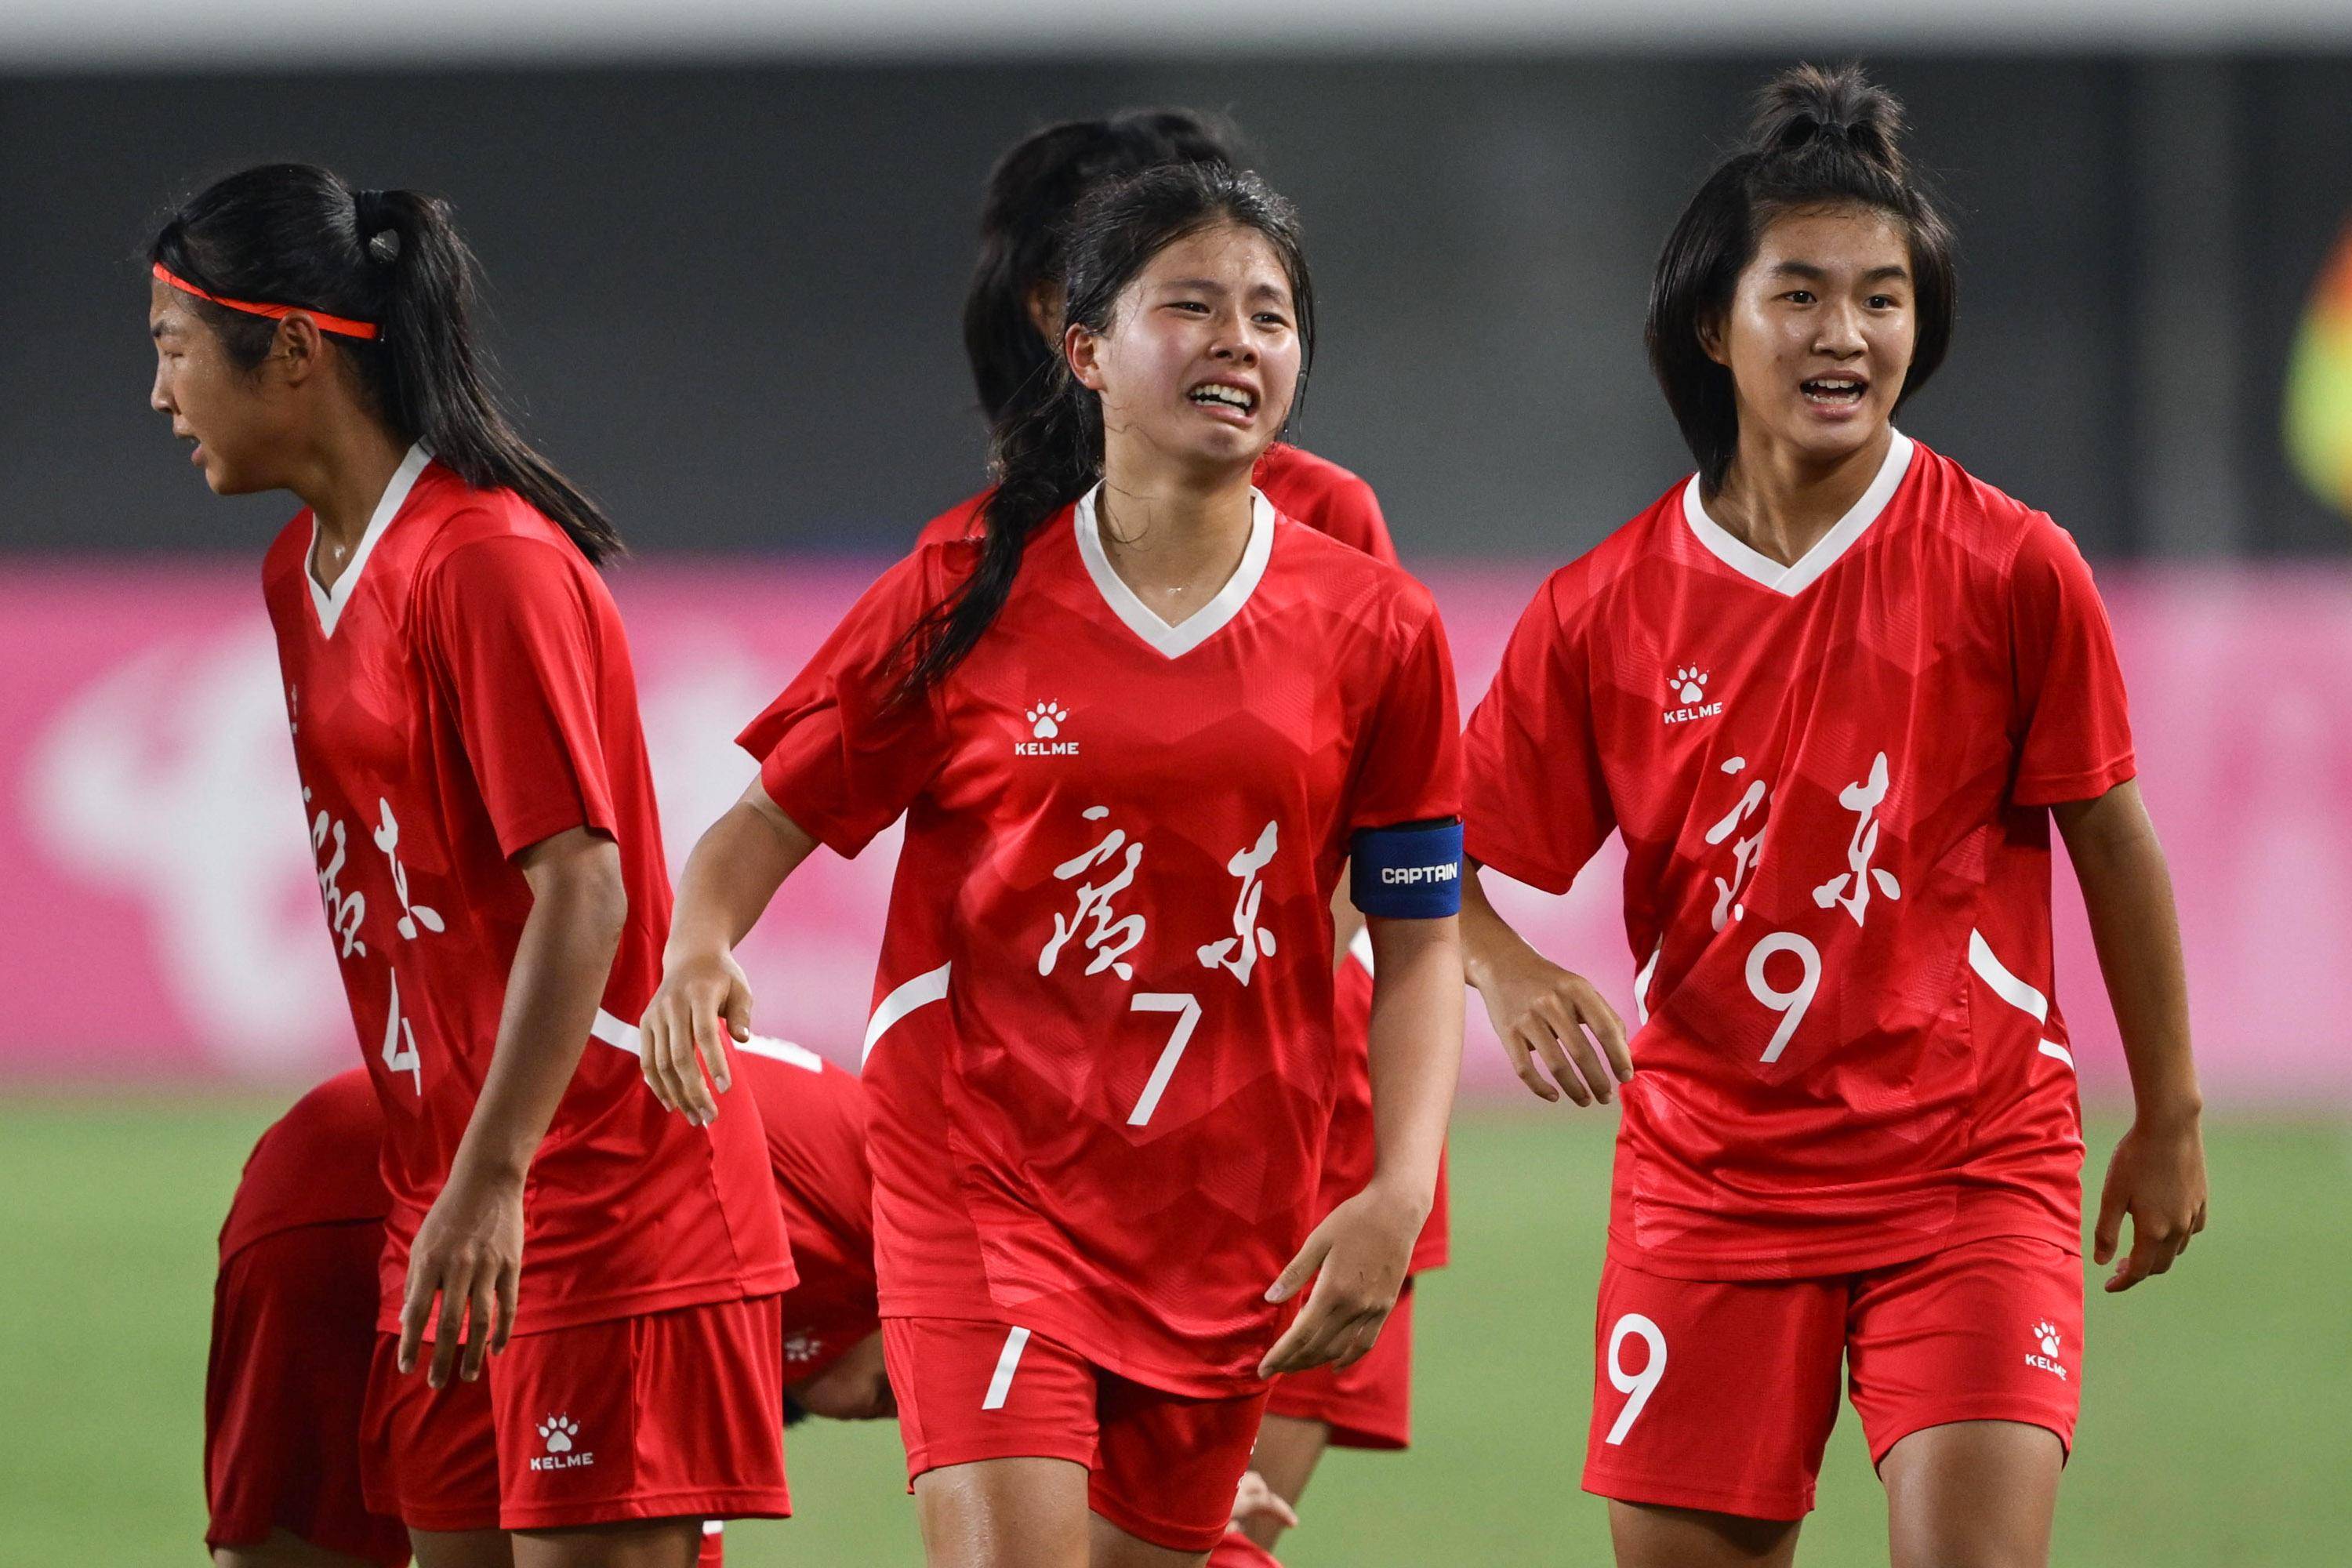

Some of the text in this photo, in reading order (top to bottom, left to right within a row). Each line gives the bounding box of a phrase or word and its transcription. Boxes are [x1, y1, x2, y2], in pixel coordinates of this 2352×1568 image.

[1014, 742, 1080, 756] KELME
[1663, 702, 1723, 724] KELME
[1381, 862, 1458, 884] CAPTAIN
[382, 967, 422, 1097] 4
[1745, 931, 1822, 1063] 9
[1126, 993, 1203, 1127] 7
[1605, 1312, 1668, 1446] 9
[530, 1452, 593, 1471] KELME
